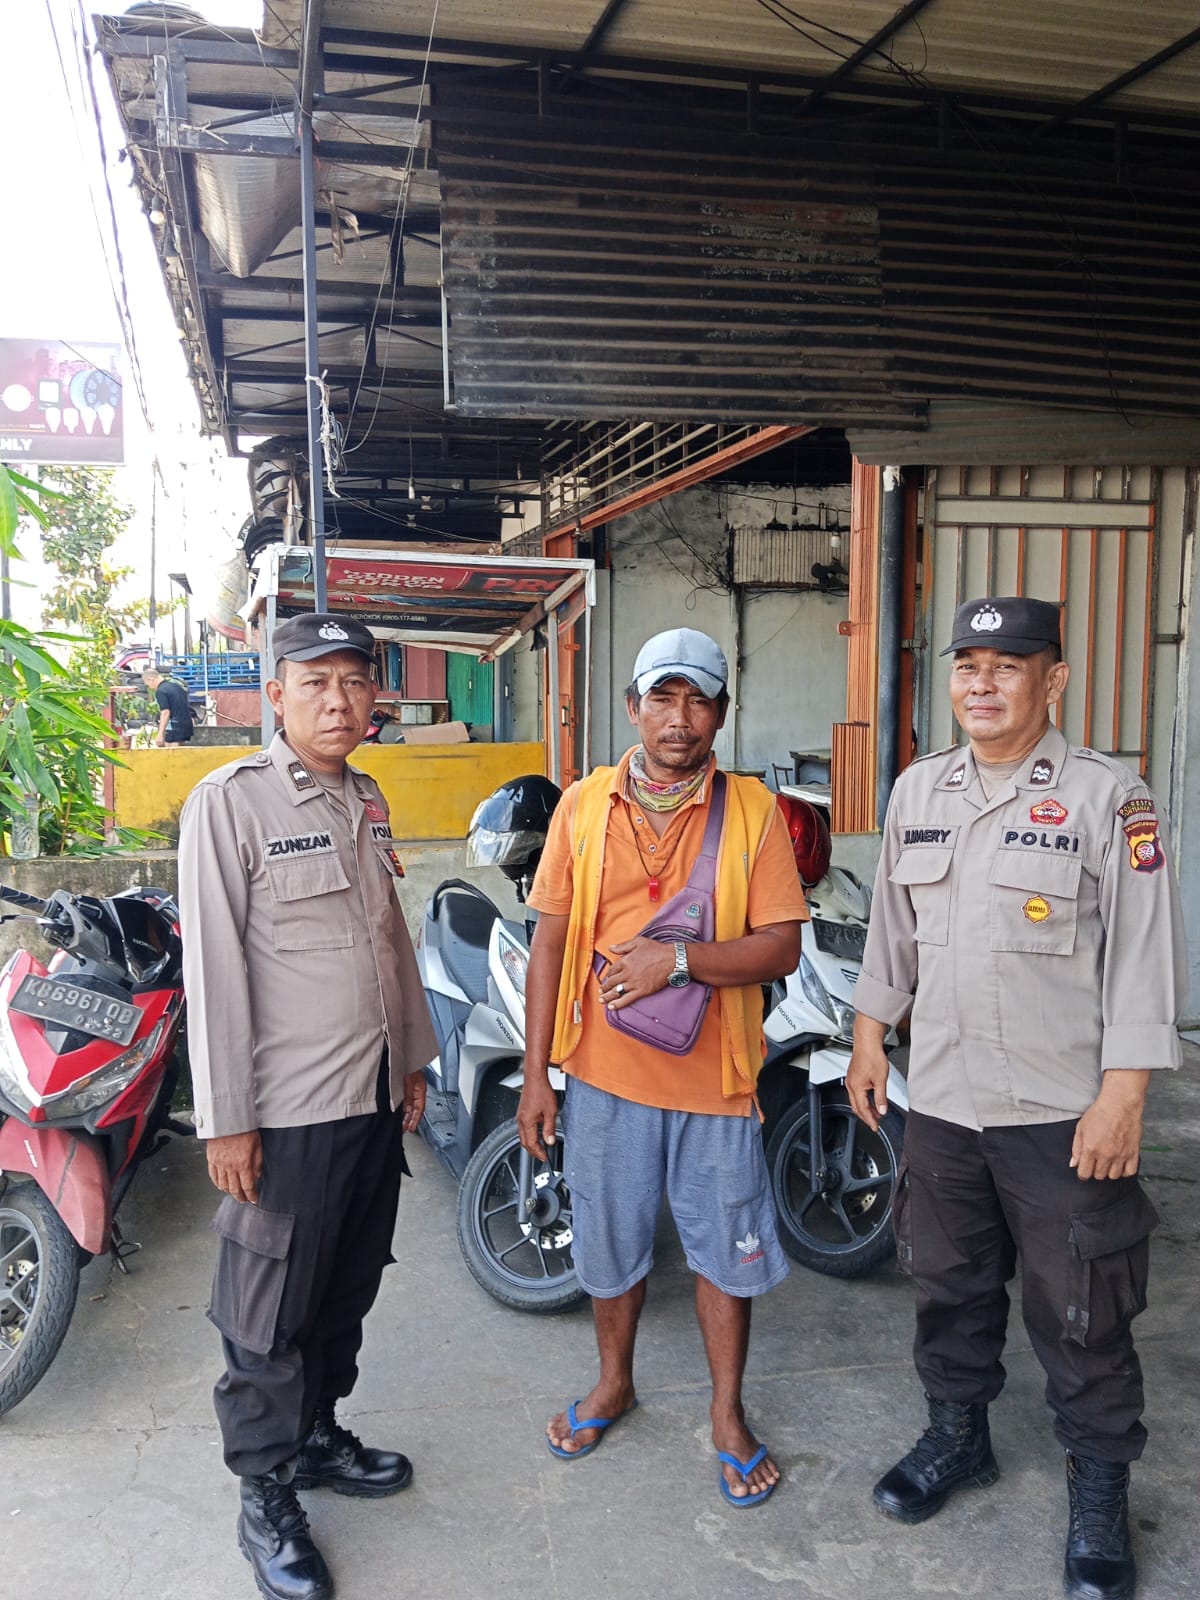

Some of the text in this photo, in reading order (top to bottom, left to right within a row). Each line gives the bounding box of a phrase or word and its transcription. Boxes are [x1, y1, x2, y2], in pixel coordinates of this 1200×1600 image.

[267, 834, 332, 856] ZUNIZAN
[903, 828, 951, 845] JUMERY
[1004, 830, 1079, 853] POLRI
[777, 1005, 796, 1031] HONDA
[495, 1016, 515, 1046] HONDA
